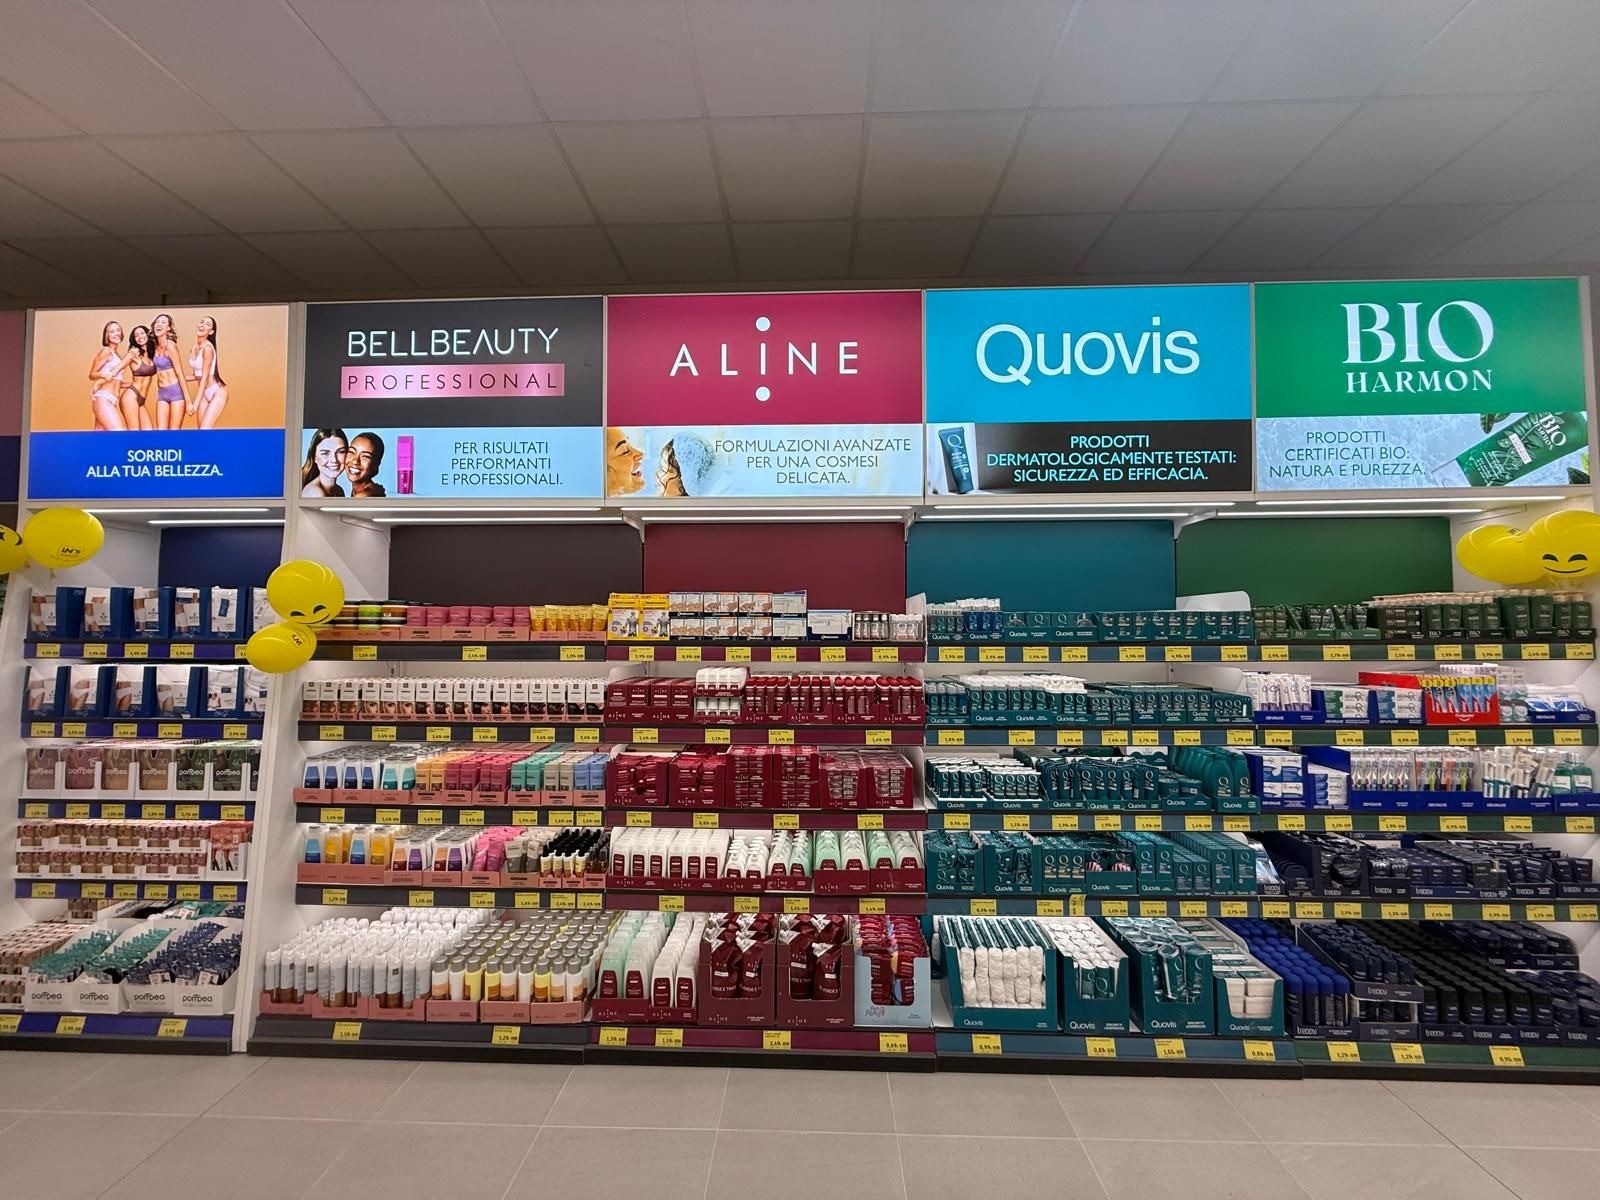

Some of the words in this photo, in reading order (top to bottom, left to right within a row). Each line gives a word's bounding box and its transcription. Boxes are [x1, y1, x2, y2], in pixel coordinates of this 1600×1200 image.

[1341, 300, 1494, 364] BIO
[347, 327, 559, 357] BELLBEAUTY
[976, 316, 1200, 386] Quovis
[347, 373, 559, 391] PROFESSIONAL
[1346, 369, 1493, 394] HARMON
[1538, 413, 1567, 446] BIO
[1070, 435, 1149, 448] PRODOTTI
[1306, 430, 1385, 444] PRODOTTI
[454, 442, 478, 454] PER
[484, 441, 548, 454] RISULTATI
[715, 439, 829, 452] FORMULAZIONI
[833, 438, 911, 451] AVANZATE
[128, 450, 182, 462] SORRIDI
[987, 452, 1173, 466] DERMATOLOGICAMENTE
[1176, 451, 1236, 464] TESTATI:
[1285, 447, 1376, 462] CERTIFICATI
[1379, 446, 1410, 460] BIO:
[452, 458, 551, 470] PERFORMANTI
[747, 456, 770, 468] PER
[777, 455, 808, 468] UNA
[815, 455, 878, 468] COSMESI
[86, 466, 120, 478] ALLA
[122, 465, 151, 477] TUA
[155, 464, 223, 477] BELLEZZA.
[1014, 468, 1099, 482] SICUREZZA
[1104, 468, 1123, 481] ED
[1128, 467, 1208, 481] EFFICACIA.
[1270, 464, 1334, 478] NATURA
[1340, 464, 1347, 477] E
[1352, 463, 1426, 477] PUREZZA.
[442, 474, 449, 485] E
[453, 473, 563, 485] PROFESSIONALI.
[776, 471, 850, 484] DELICATA.
[179, 768, 204, 776] pompea
[216, 768, 241, 777] pompea
[32, 991, 62, 1000] pompea
[79, 991, 109, 1001] pompea
[134, 992, 165, 1001] pompea
[182, 993, 213, 1002] pompea
[1070, 1021, 1095, 1030] Quovis
[1151, 1020, 1177, 1029] Quovis
